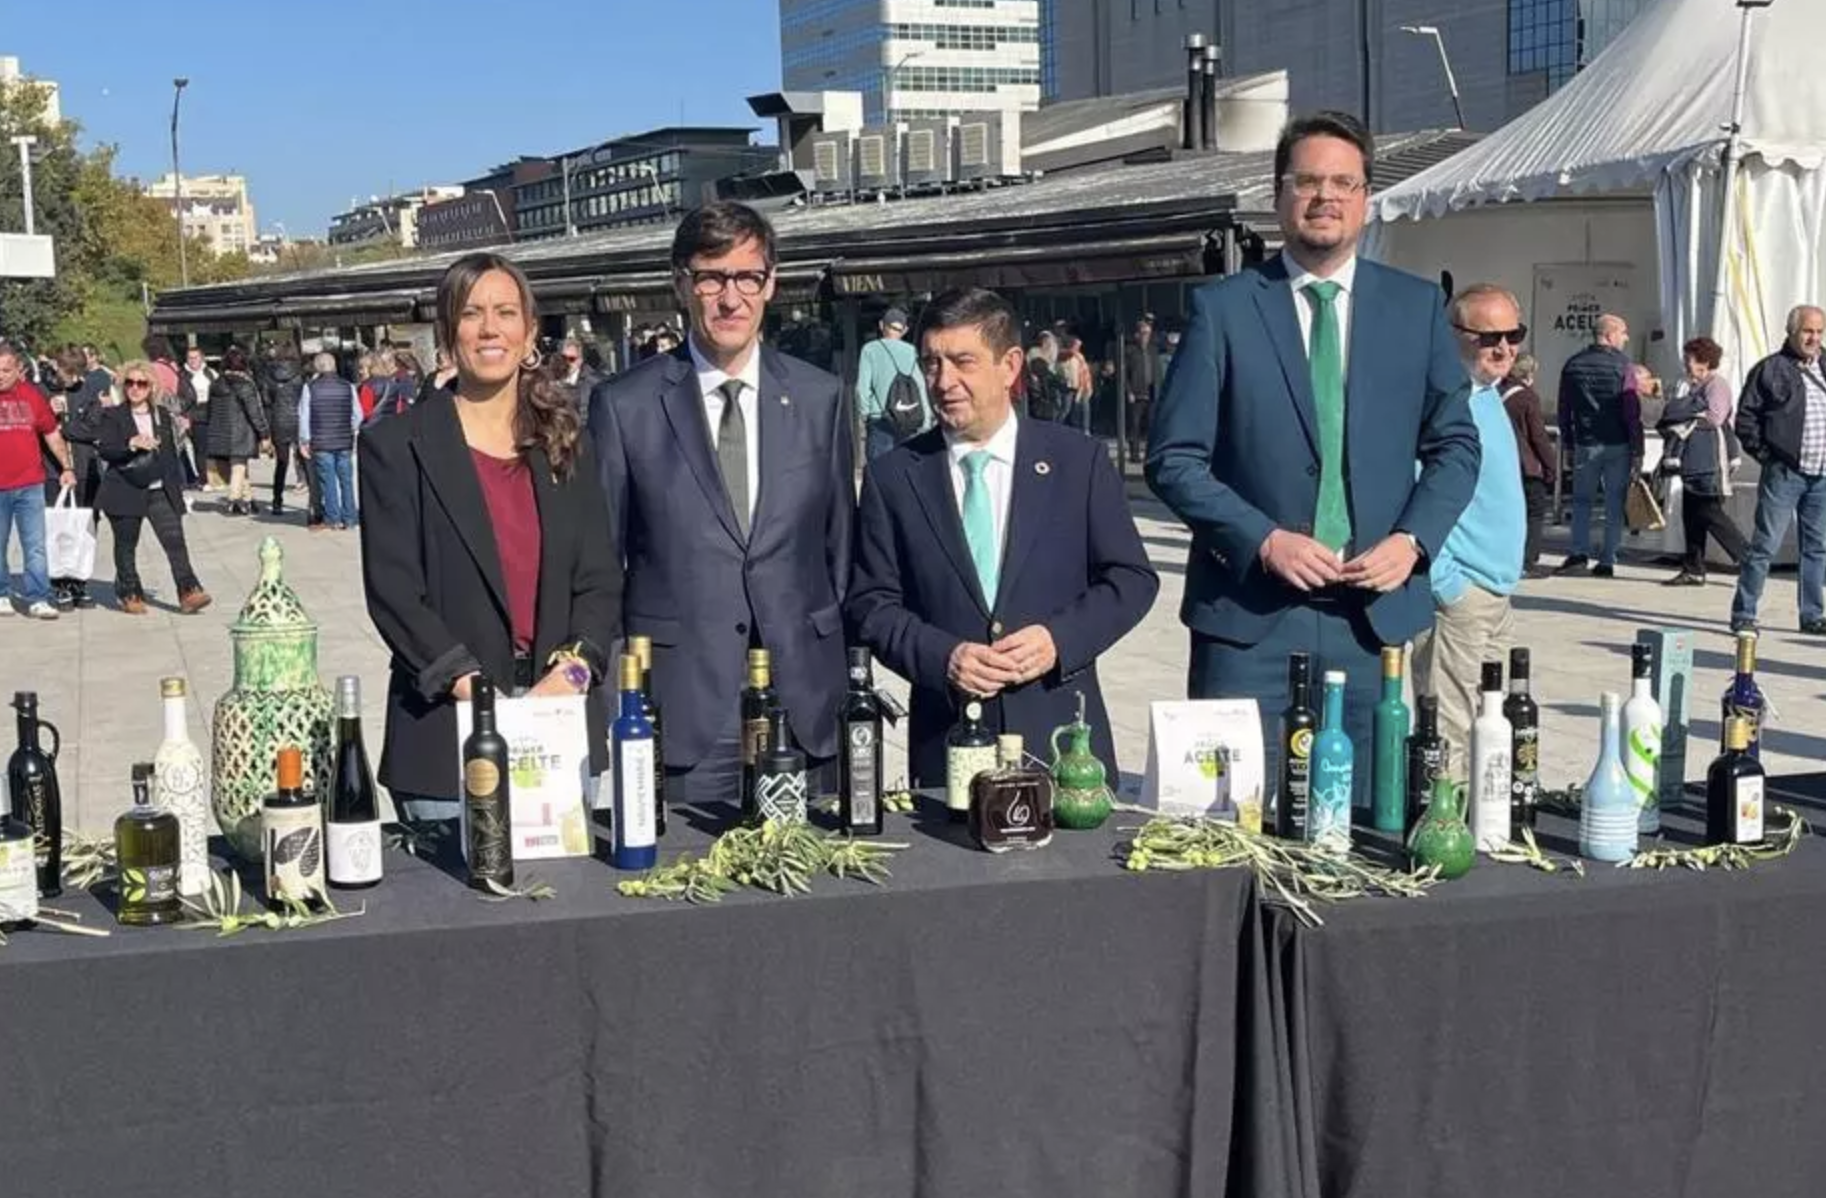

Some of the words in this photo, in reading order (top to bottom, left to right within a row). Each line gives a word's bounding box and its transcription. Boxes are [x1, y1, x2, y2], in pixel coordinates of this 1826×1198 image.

[842, 275, 884, 292] VIENA
[508, 754, 563, 772] CEITE
[1184, 748, 1242, 764] ACEITE
